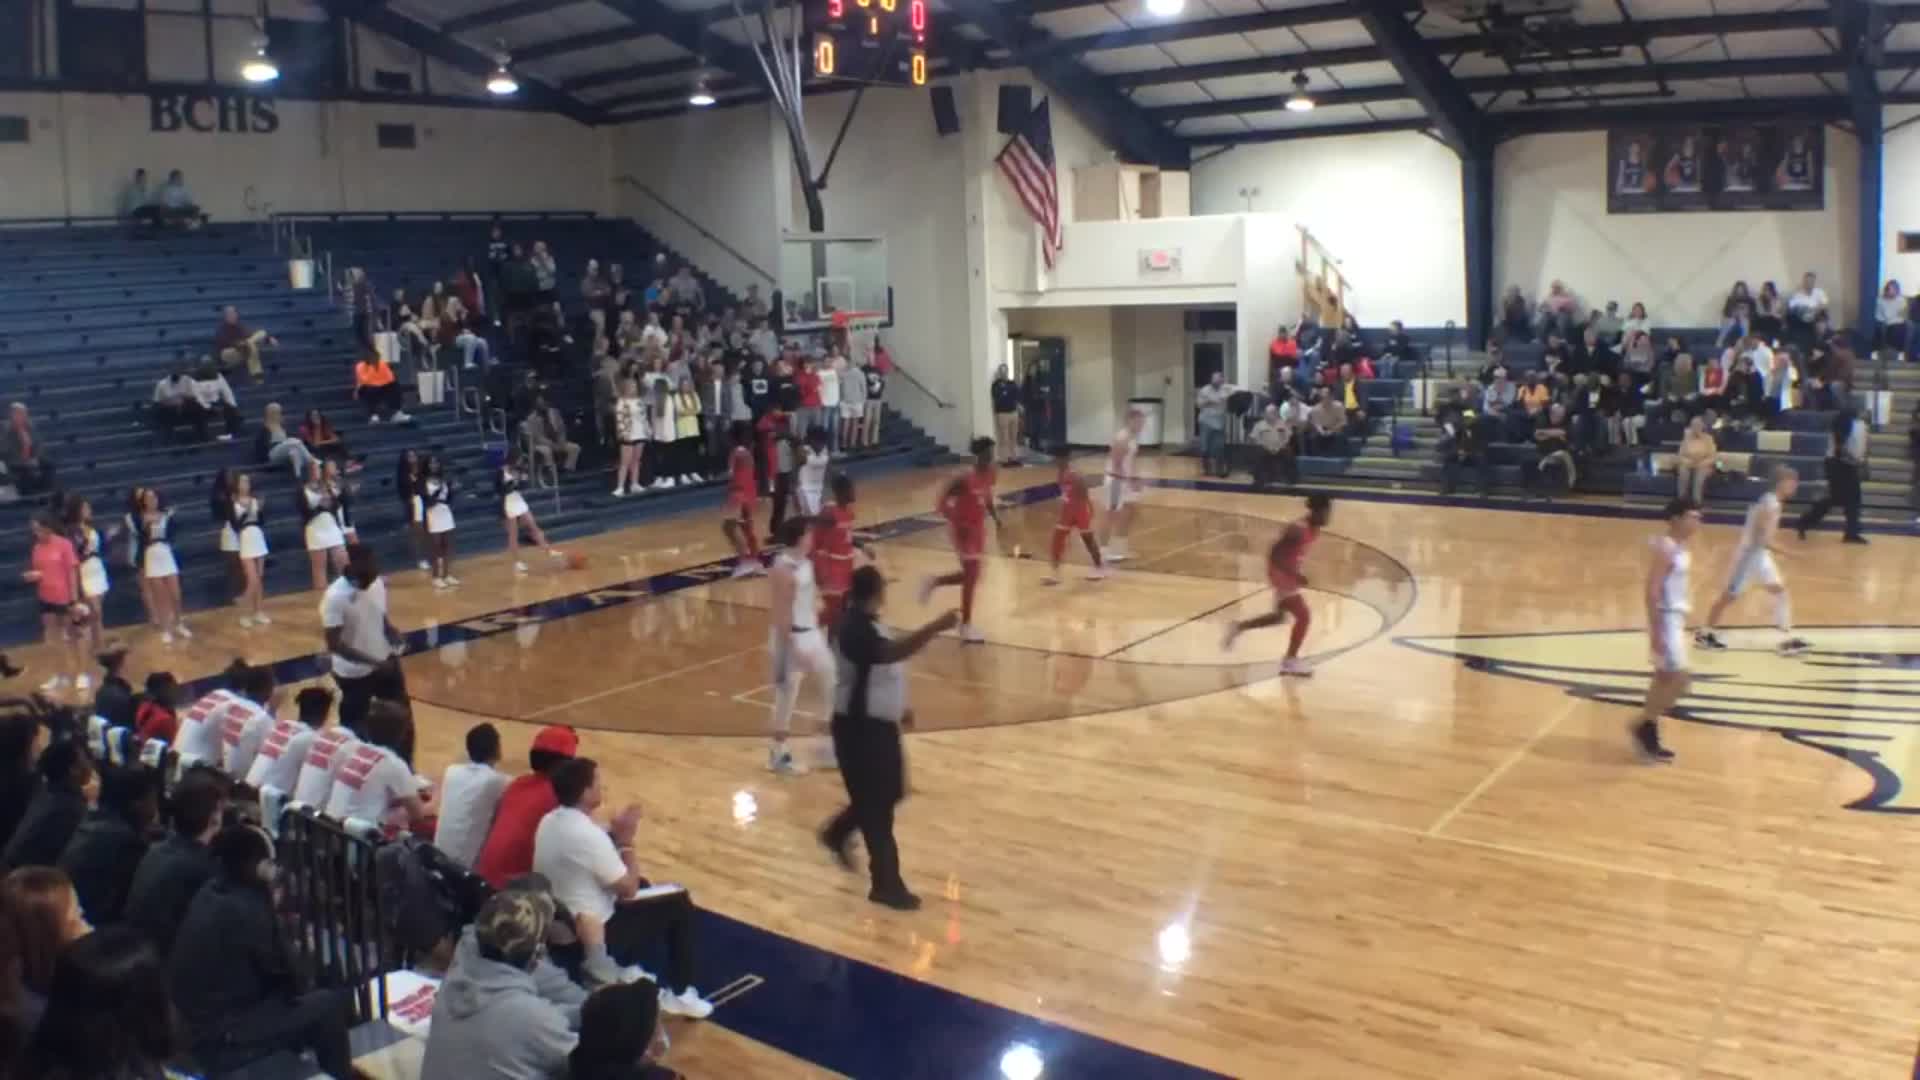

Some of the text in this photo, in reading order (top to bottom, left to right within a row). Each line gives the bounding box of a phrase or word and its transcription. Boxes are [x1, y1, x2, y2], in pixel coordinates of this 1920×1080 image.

[911, 0, 925, 31] 0
[818, 40, 834, 74] 0
[912, 54, 925, 85] 0
[151, 96, 279, 133] BCHS
